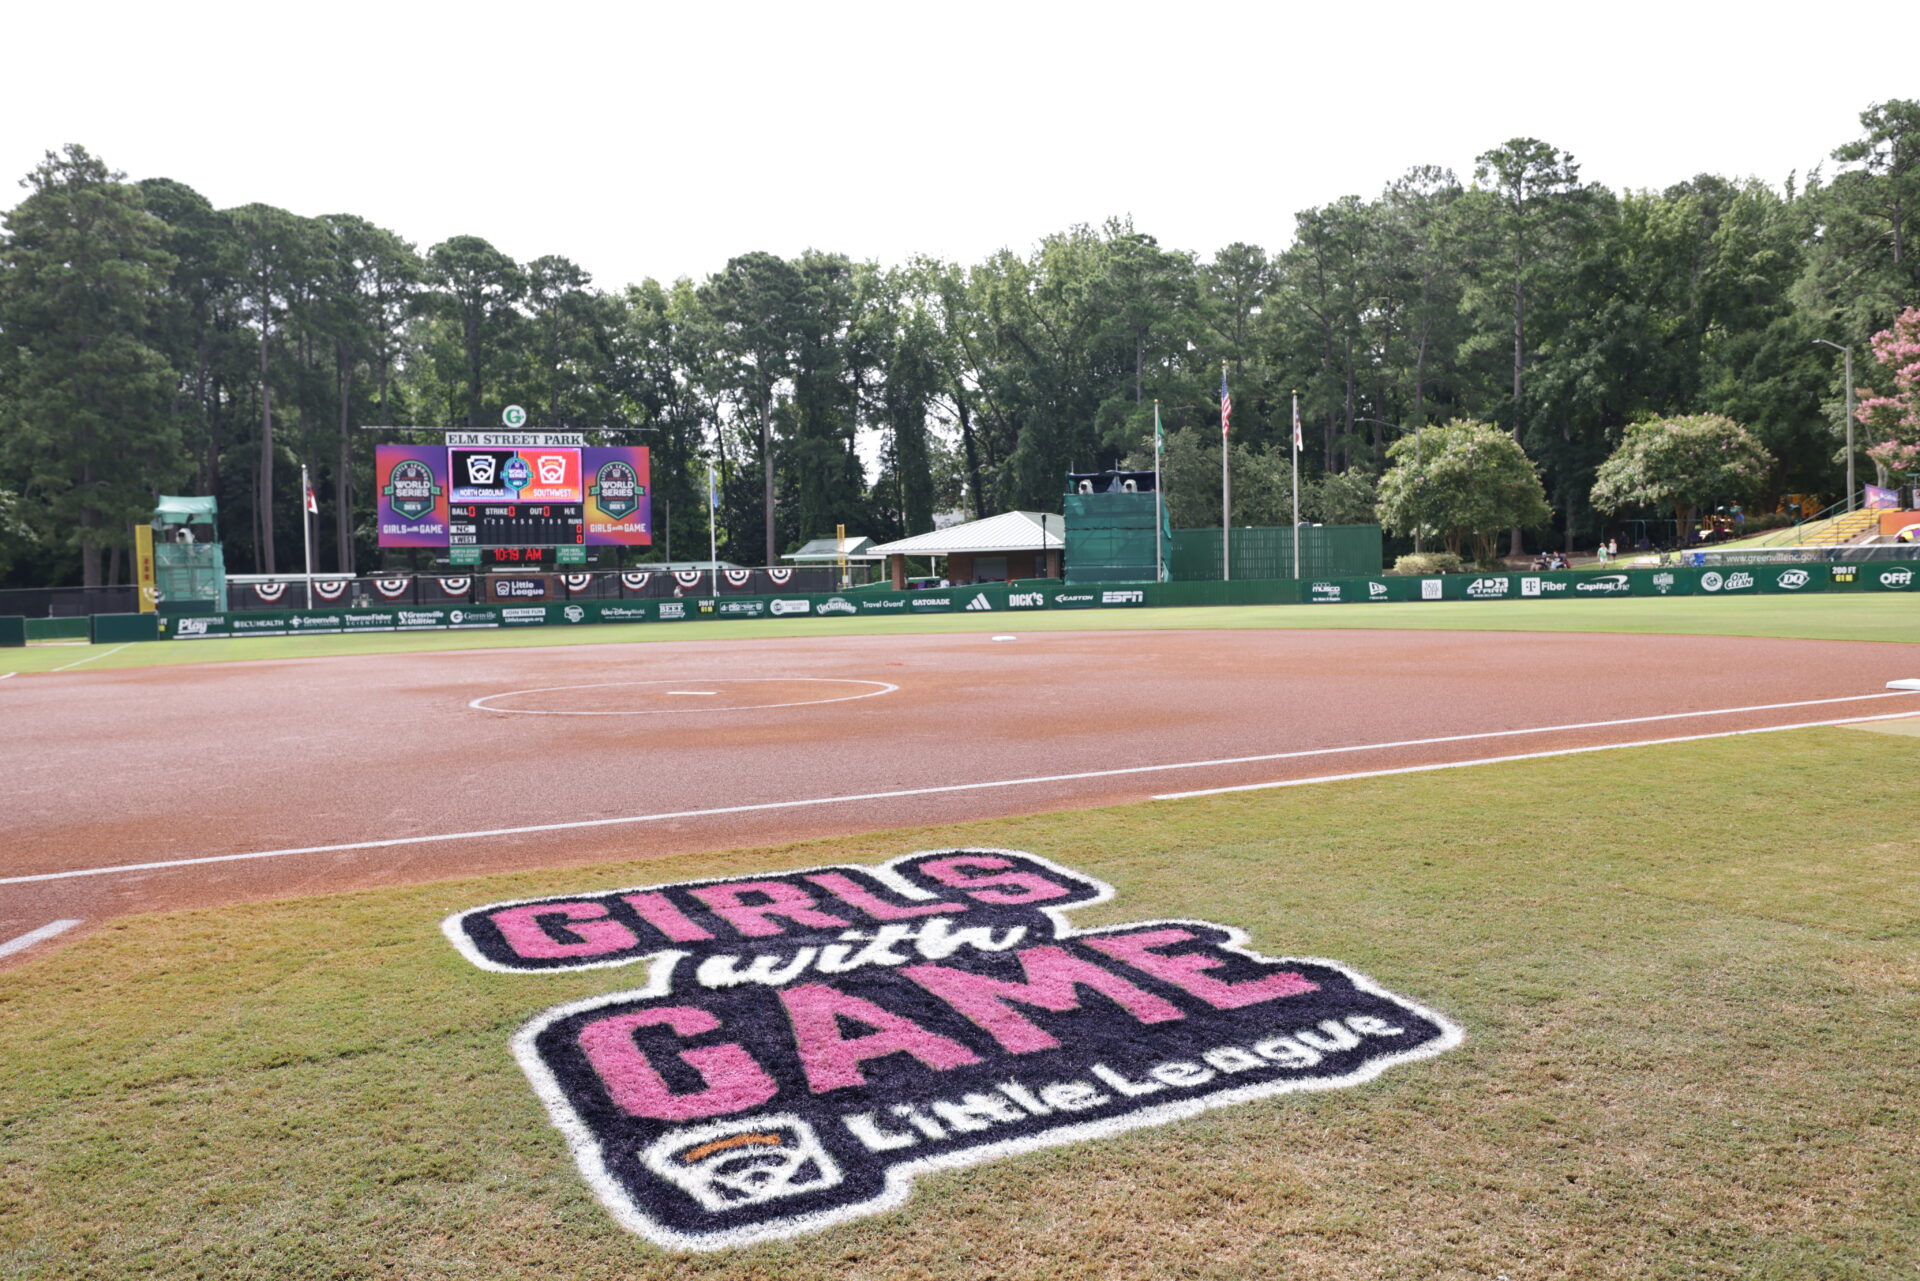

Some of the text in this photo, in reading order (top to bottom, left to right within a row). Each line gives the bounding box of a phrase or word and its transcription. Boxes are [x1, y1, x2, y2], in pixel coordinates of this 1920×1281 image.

[448, 434, 581, 446] ELM STREET PARK
[394, 481, 431, 489] WORLD
[600, 481, 634, 489] WORLD
[395, 488, 430, 497] SERIES
[460, 489, 480, 497] NORTH
[533, 489, 572, 497] SOUTHWEST
[601, 489, 634, 497] SERIES
[451, 507, 468, 516] BALL
[485, 507, 508, 516] STRIKE
[529, 507, 543, 516] OUT
[564, 507, 576, 515] H/E
[383, 524, 407, 534] GIRLS
[419, 524, 443, 534] GAME
[590, 524, 612, 533] GIRLS
[624, 524, 646, 533] GAME
[494, 549, 543, 561] 10:19 AM
[1726, 553, 1817, 563] www.greenvillenc.gov
[1731, 573, 1748, 582] OXI
[1783, 573, 1805, 584] DQ
[1880, 572, 1911, 585] OFF!
[1541, 581, 1567, 591] Fiber
[1576, 582, 1612, 592] Capital
[1725, 578, 1753, 589] CLEAN
[511, 588, 544, 597] League
[1102, 591, 1143, 603] ESPN
[1009, 592, 1044, 607] DICK'S
[178, 617, 207, 633] Play
[303, 616, 339, 624] Greenville
[486, 855, 1069, 958] GIRLS
[696, 917, 1027, 989] with
[578, 928, 1320, 1121] GAME
